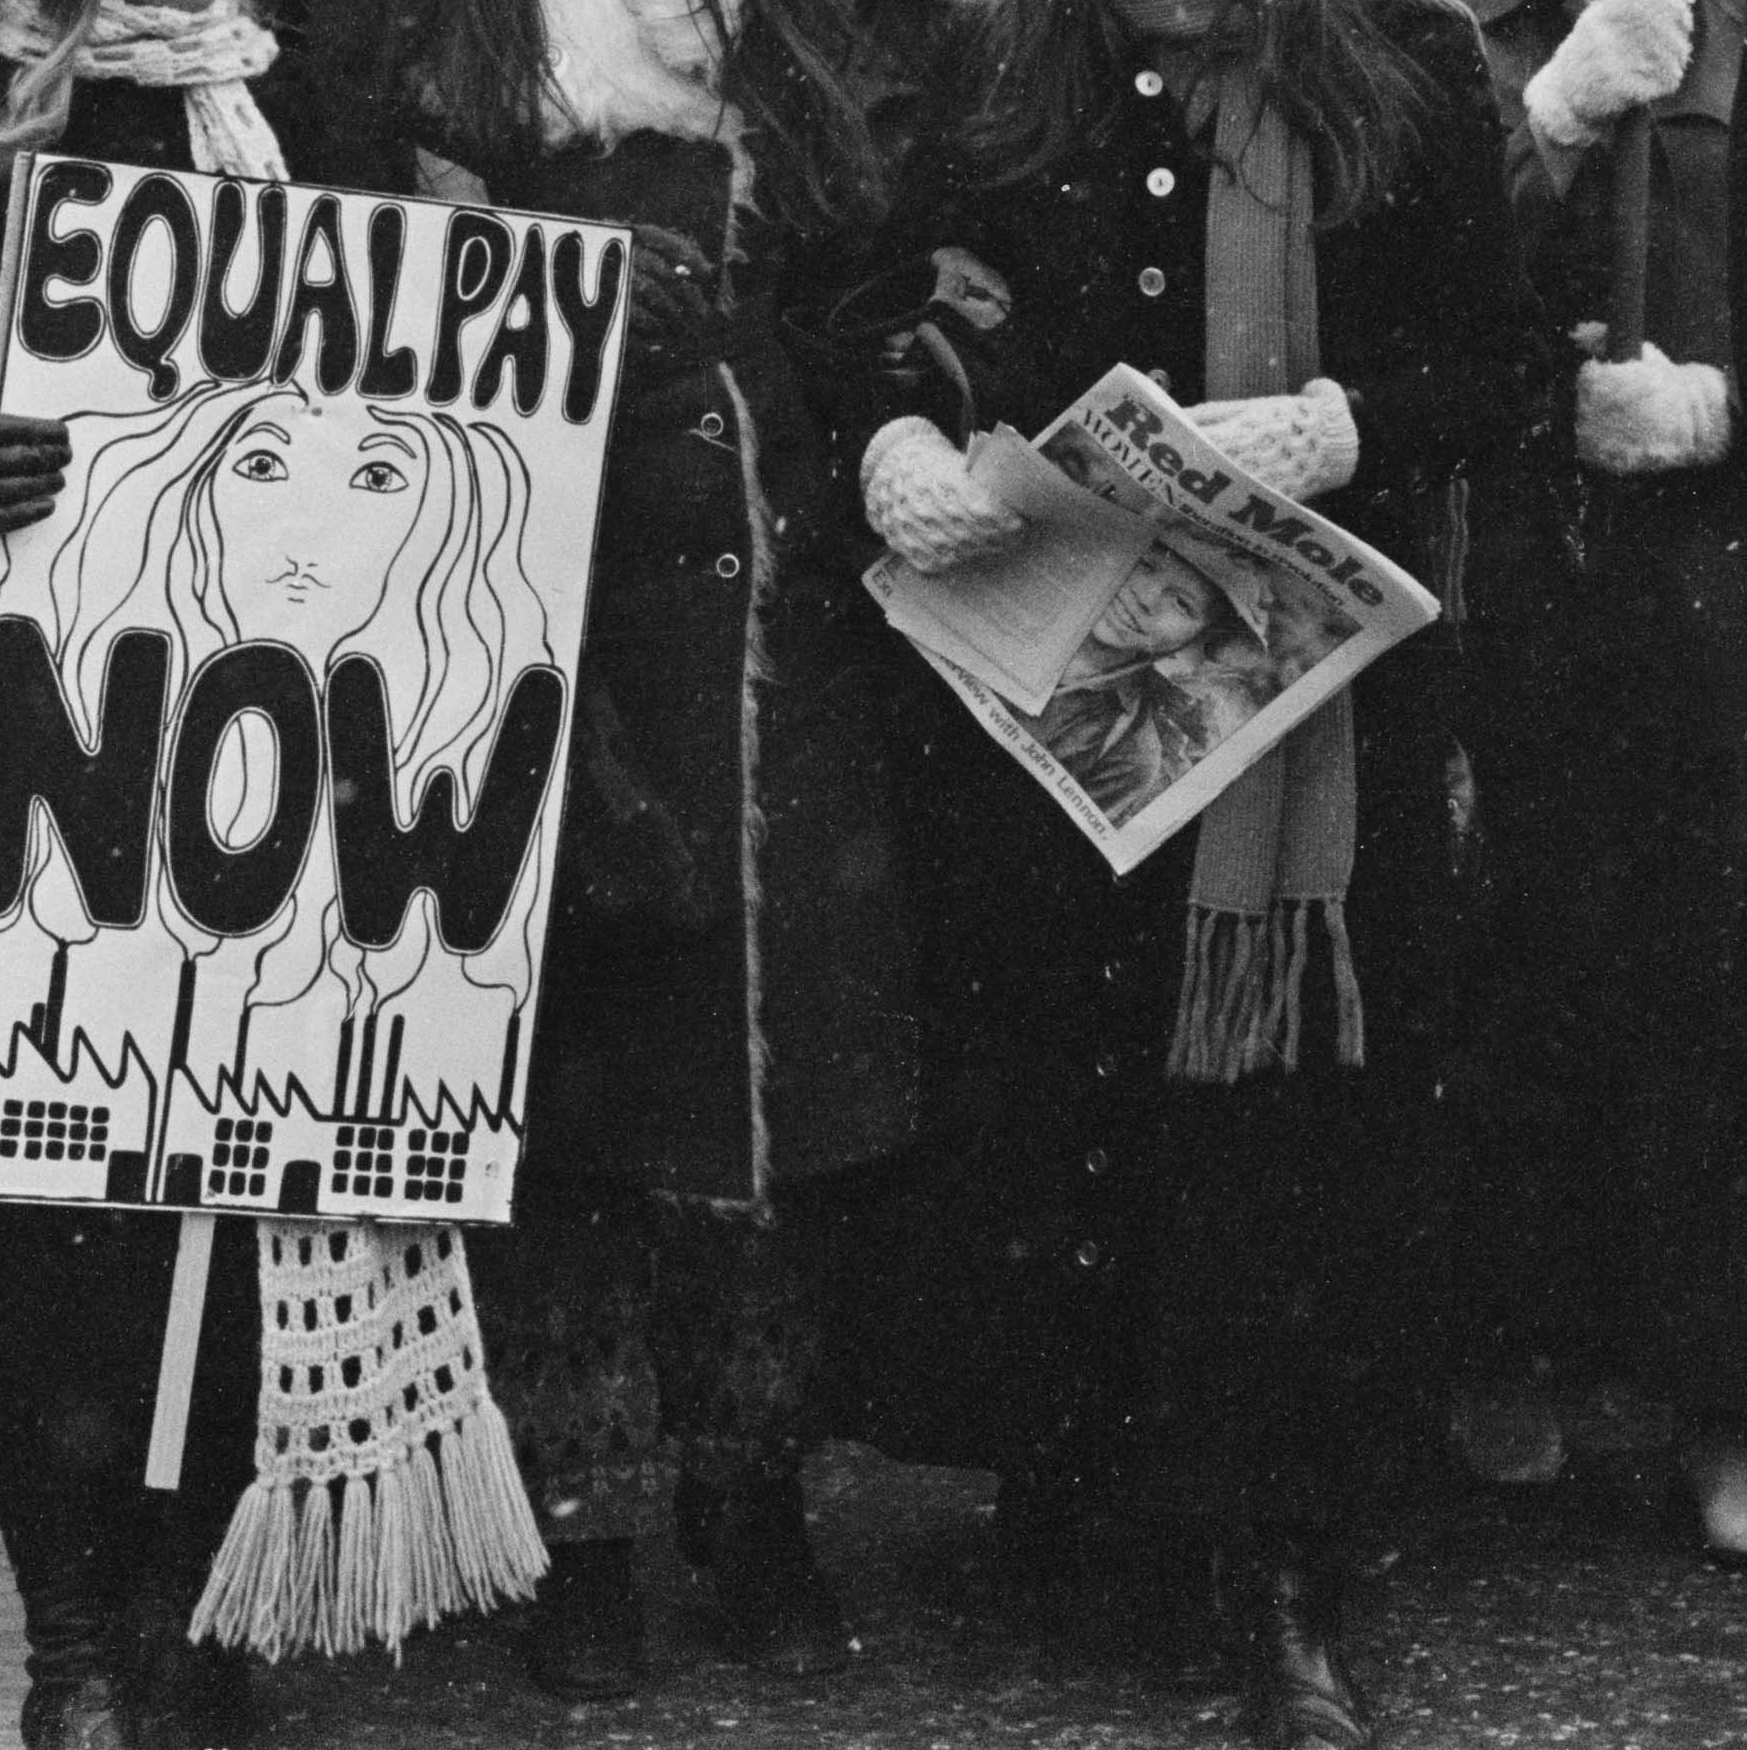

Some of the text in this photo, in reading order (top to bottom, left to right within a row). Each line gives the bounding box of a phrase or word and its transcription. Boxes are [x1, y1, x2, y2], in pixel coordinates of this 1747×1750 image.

[18, 160, 624, 424] EQUAL PAY
[1105, 394, 1233, 505] Red
[1227, 494, 1385, 607] Mole
[988, 707, 1021, 742] with
[1019, 743, 1056, 777] John
